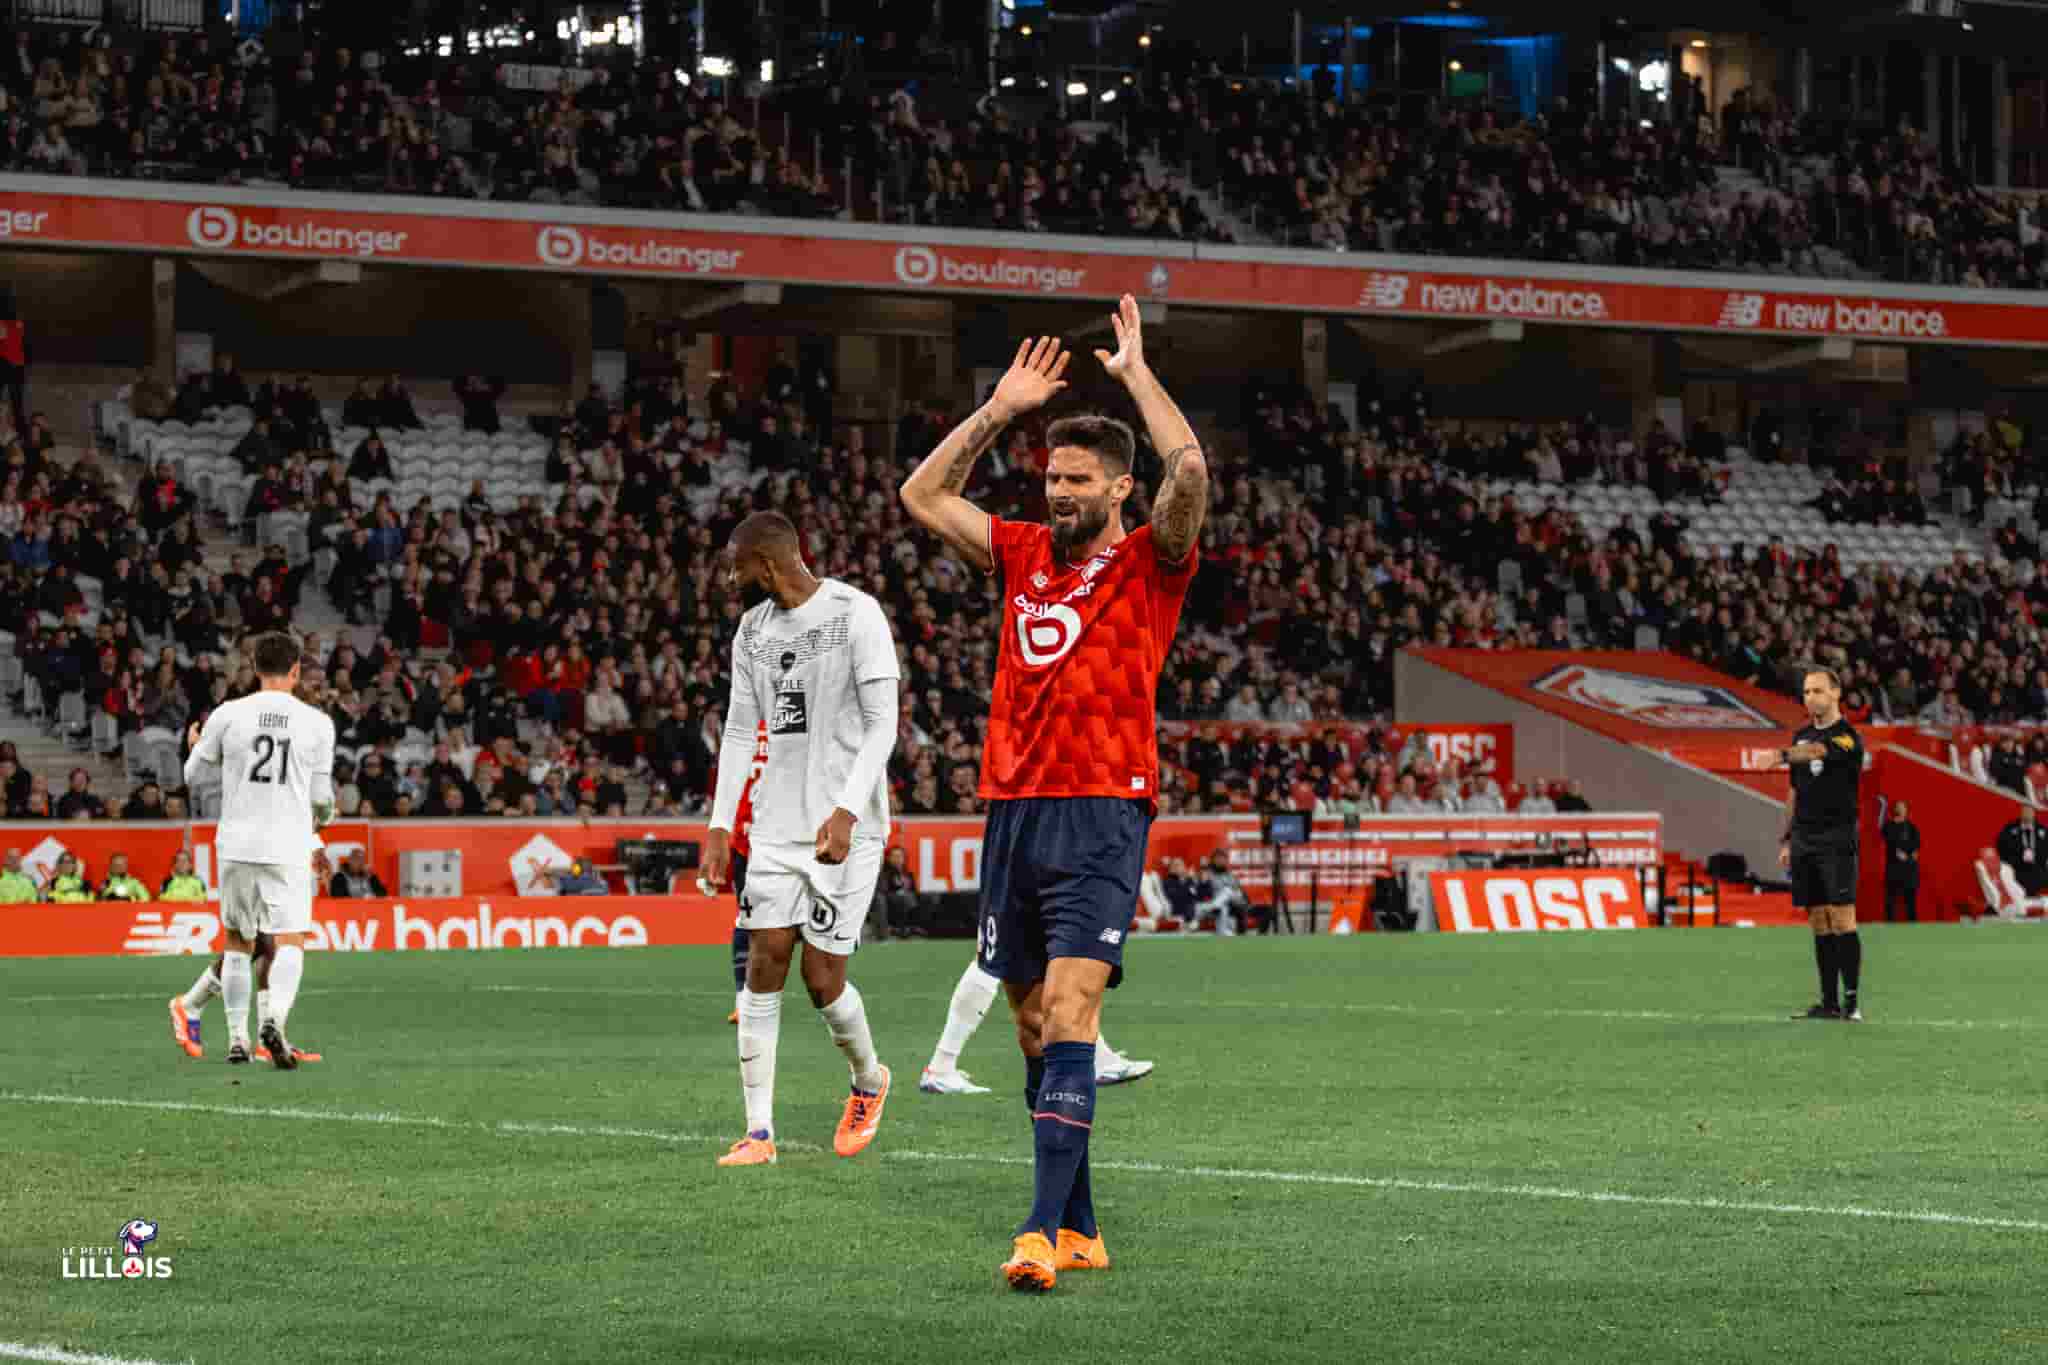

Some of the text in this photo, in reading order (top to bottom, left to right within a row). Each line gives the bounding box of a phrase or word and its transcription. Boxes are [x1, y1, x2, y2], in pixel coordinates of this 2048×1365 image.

[242, 218, 408, 256] boulanger
[587, 238, 743, 273] boulanger
[941, 255, 1087, 292] boulanger
[1421, 282, 1479, 312] new
[1486, 278, 1607, 319] balance
[1775, 301, 1829, 329] new
[1834, 298, 1946, 337] balance
[249, 733, 291, 785] 21
[1426, 733, 1496, 769] OSC
[1445, 877, 1636, 933] LOSC
[303, 918, 378, 950] ew
[393, 903, 650, 950] balance
[1044, 1091, 1089, 1106] LOSC
